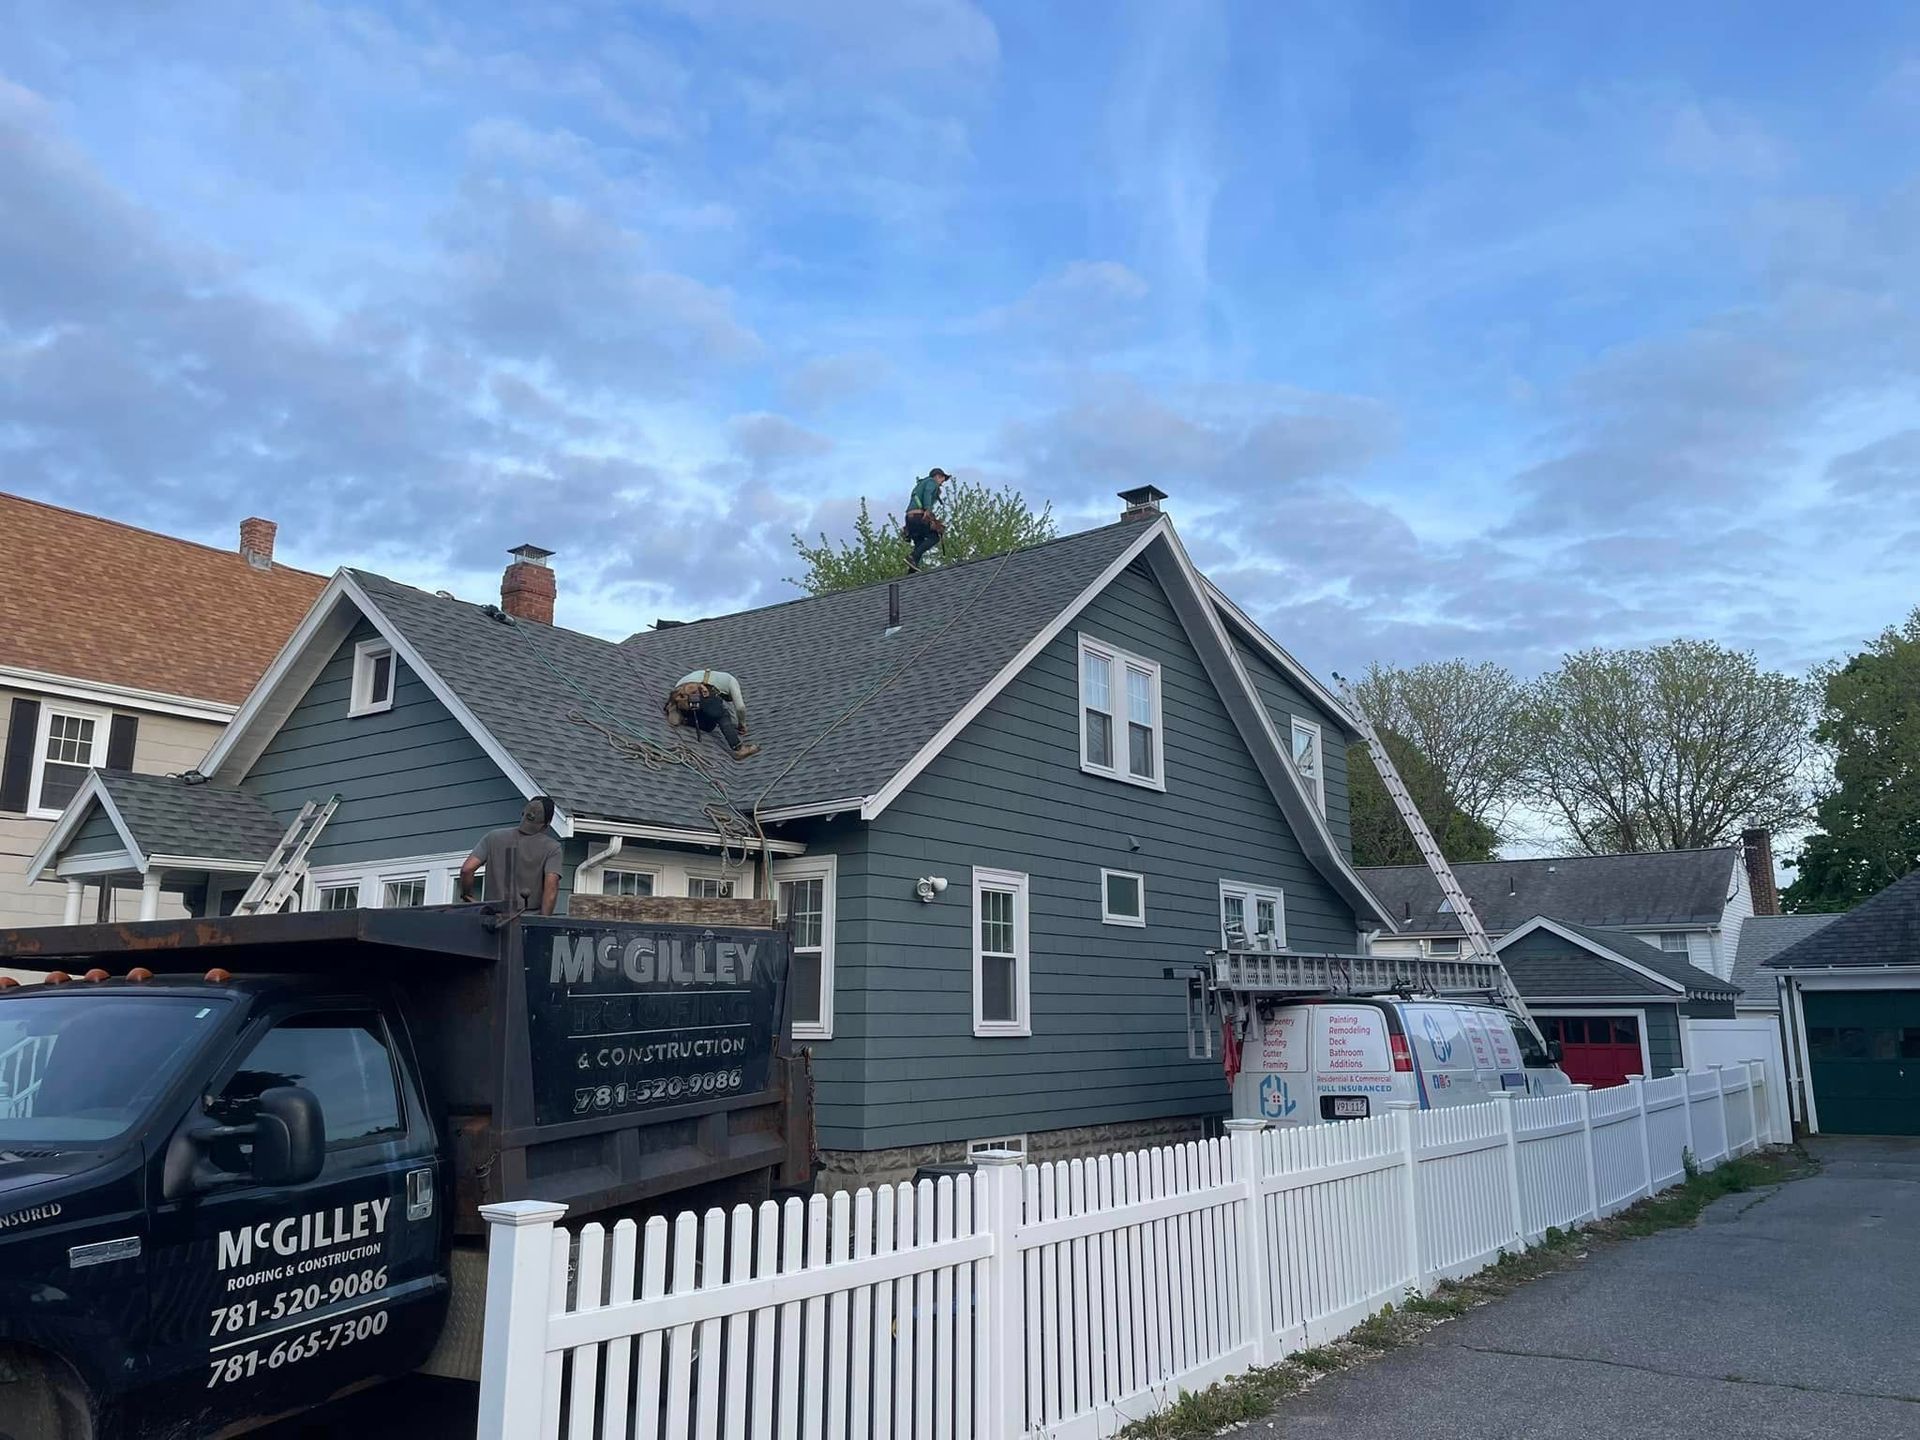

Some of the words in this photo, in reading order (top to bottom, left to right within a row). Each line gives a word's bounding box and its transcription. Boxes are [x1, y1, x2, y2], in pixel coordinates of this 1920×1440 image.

[1329, 1016, 1358, 1025] Painting
[1329, 1026, 1371, 1035] Remodeling
[1329, 1038, 1347, 1046] Deck
[578, 1052, 590, 1069] &
[597, 1037, 746, 1067] CONSTRUCTION
[1263, 1049, 1282, 1058] Gutter
[1329, 1048, 1364, 1057] Bathroom
[1263, 1060, 1288, 1071] Framing
[1329, 1060, 1364, 1069] Additions
[1317, 1075, 1349, 1083] Residential
[1355, 1075, 1392, 1083] Commercial
[574, 1065, 743, 1114] 781-520-9086
[218, 1197, 391, 1271] McGILLEY
[227, 1267, 283, 1292] ROOFING
[285, 1264, 295, 1277] &
[298, 1242, 382, 1275] CONSTRUCTION
[209, 1265, 388, 1337] 781-520-9086
[207, 1310, 389, 1389] 781-665-7300
